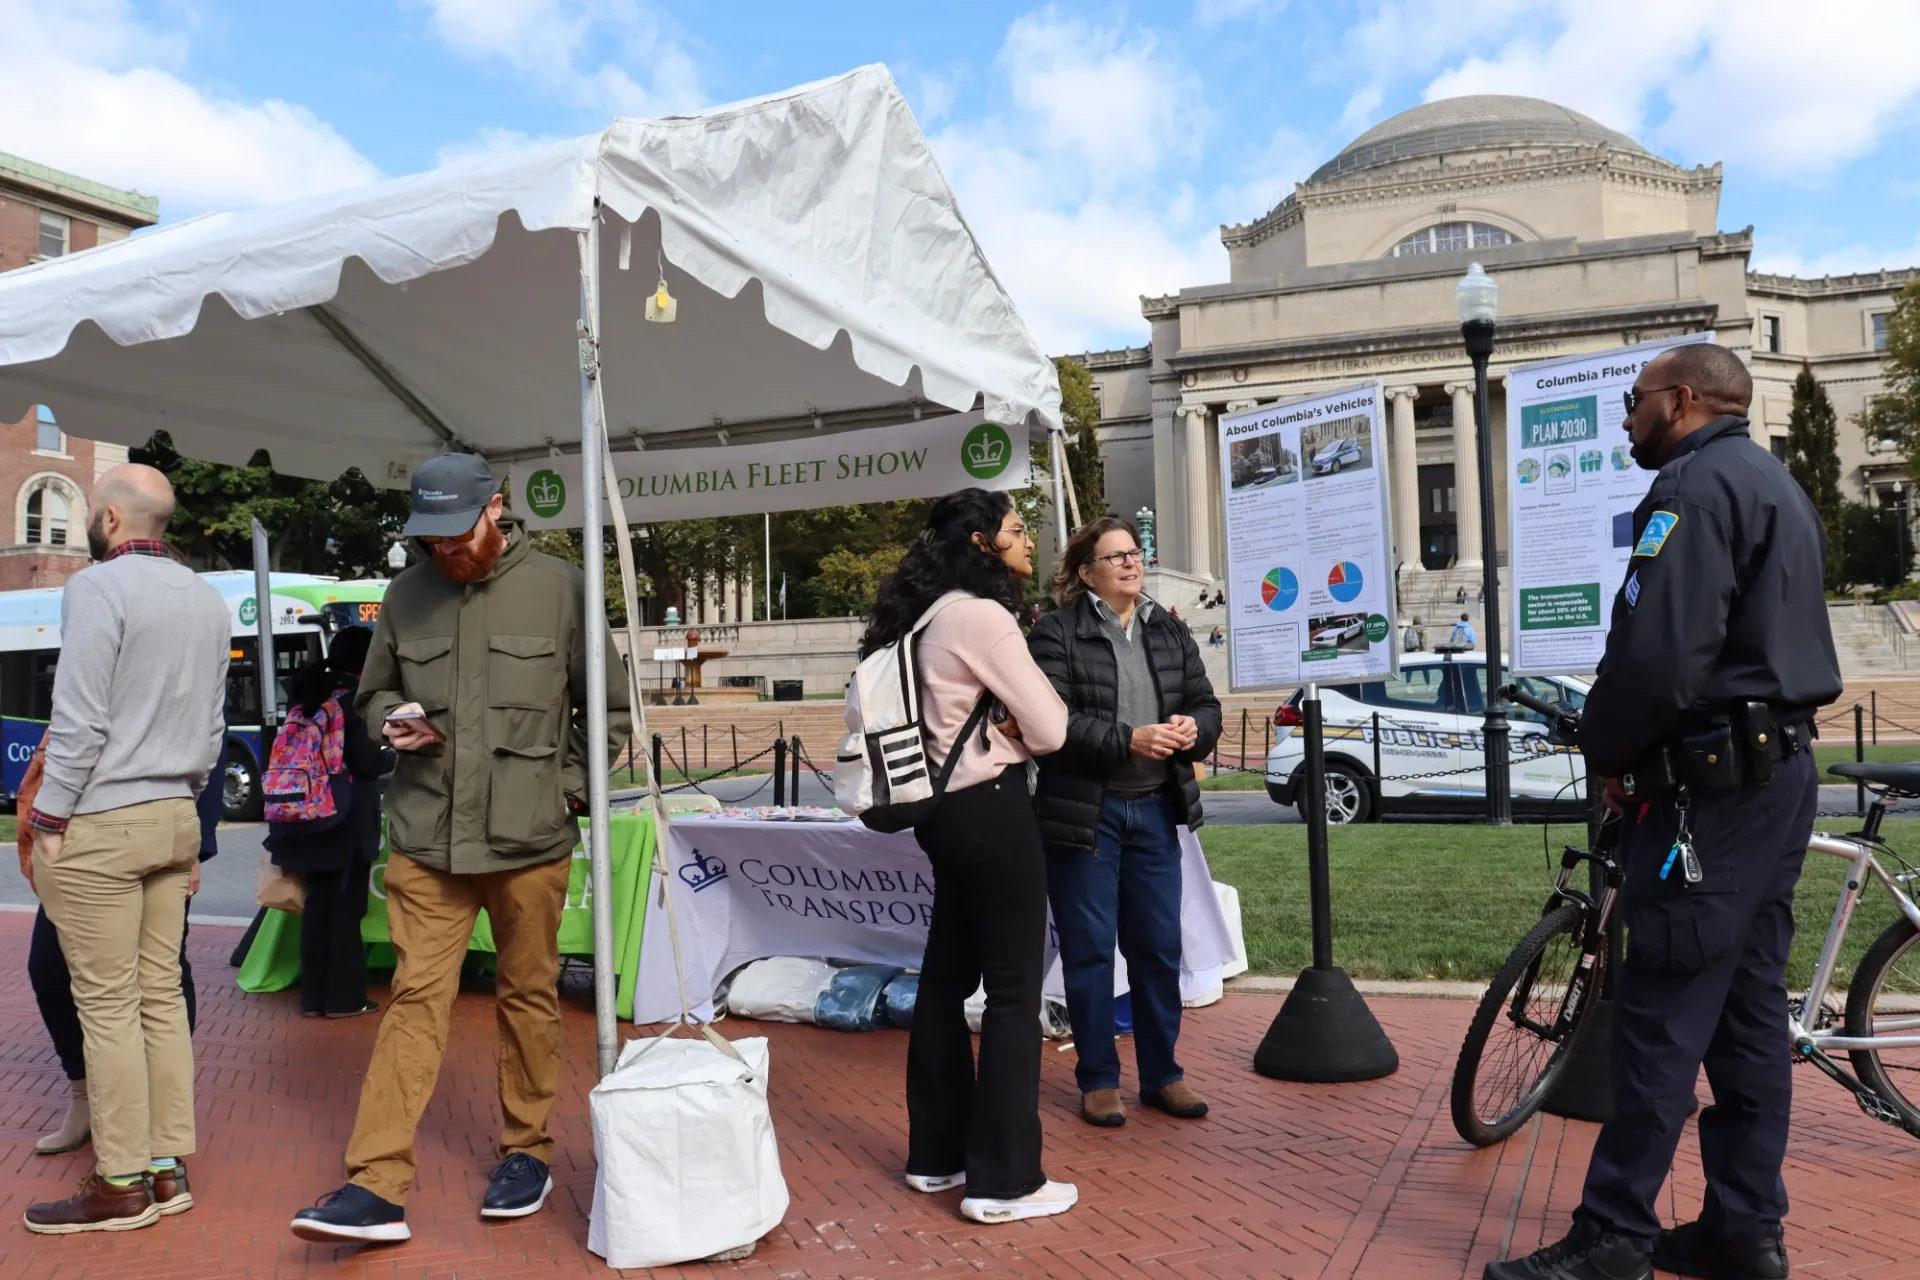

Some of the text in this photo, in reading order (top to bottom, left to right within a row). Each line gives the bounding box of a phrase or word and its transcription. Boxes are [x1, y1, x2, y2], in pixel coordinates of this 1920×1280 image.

[1305, 340, 1561, 373] THE LIBRARY OF COLUMB NIVERSITY
[1536, 363, 1637, 389] Columbia Fleet
[1226, 396, 1374, 437] About Columbia's Vehicles
[1532, 417, 1587, 443] PLAN 2030
[747, 459, 827, 489] FLEET
[836, 448, 928, 480] SHOW
[1540, 592, 1583, 600] transportation
[1553, 598, 1588, 607] responsible
[1527, 615, 1557, 623] emissions
[1361, 728, 1454, 749] PUBLIC
[1459, 732, 1556, 754] SETY
[739, 858, 936, 895] COLUMBIA
[752, 884, 935, 927] TRANSPOR
